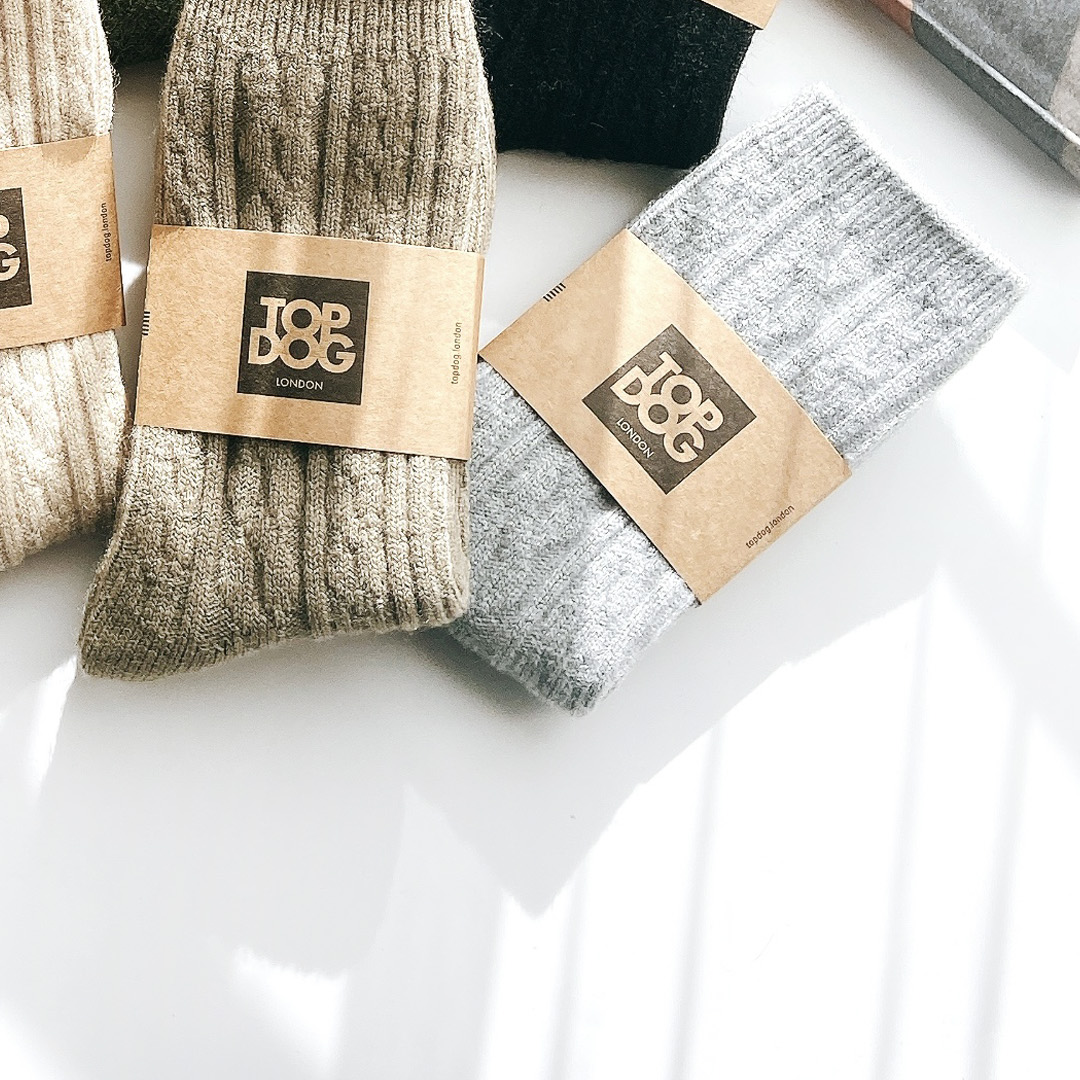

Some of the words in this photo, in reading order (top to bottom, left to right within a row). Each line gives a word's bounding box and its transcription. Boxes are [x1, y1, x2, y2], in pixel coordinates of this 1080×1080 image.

[260, 296, 352, 331] TOP
[248, 326, 357, 374] DOG
[275, 377, 324, 391] LONDON
[649, 351, 724, 432] TOP
[609, 365, 705, 463] DOG
[615, 417, 655, 459] LONDON
